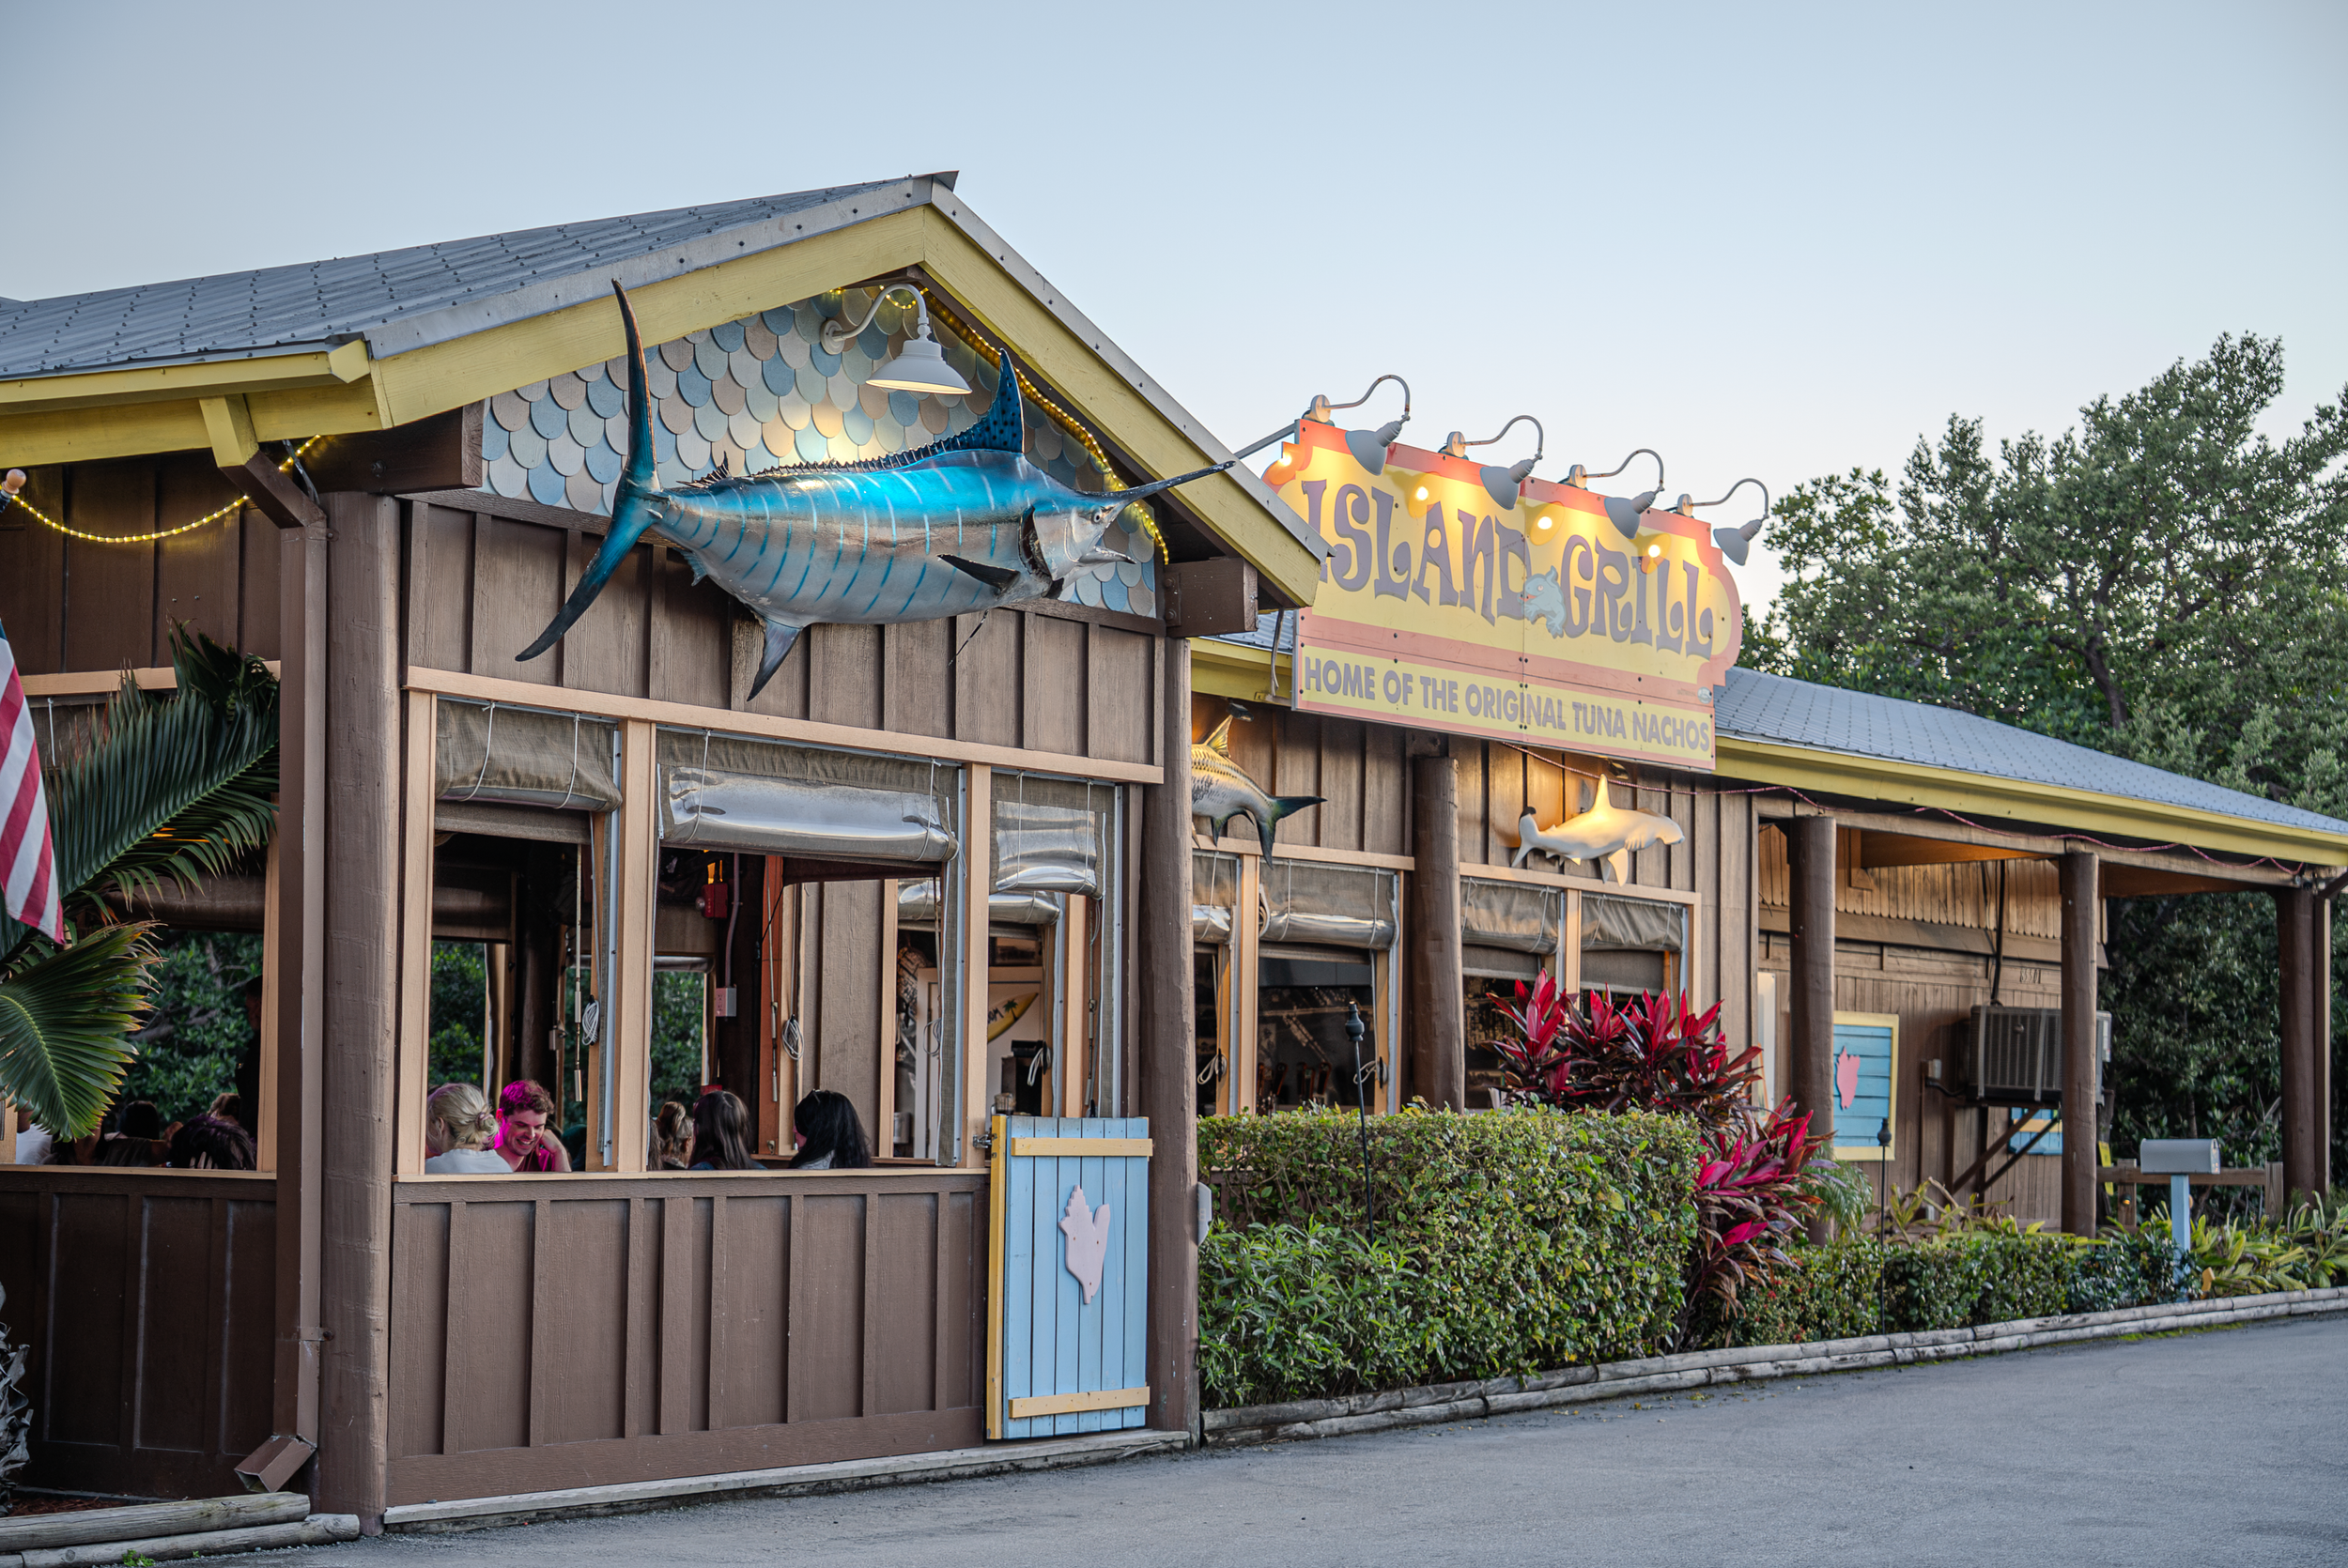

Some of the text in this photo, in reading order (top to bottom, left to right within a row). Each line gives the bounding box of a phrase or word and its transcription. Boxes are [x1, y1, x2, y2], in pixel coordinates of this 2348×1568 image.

[1301, 479, 1713, 661] ISLAND GRILL
[1305, 655, 1710, 751] HOME OF THE ORIGINAL TUNA NACHOS
